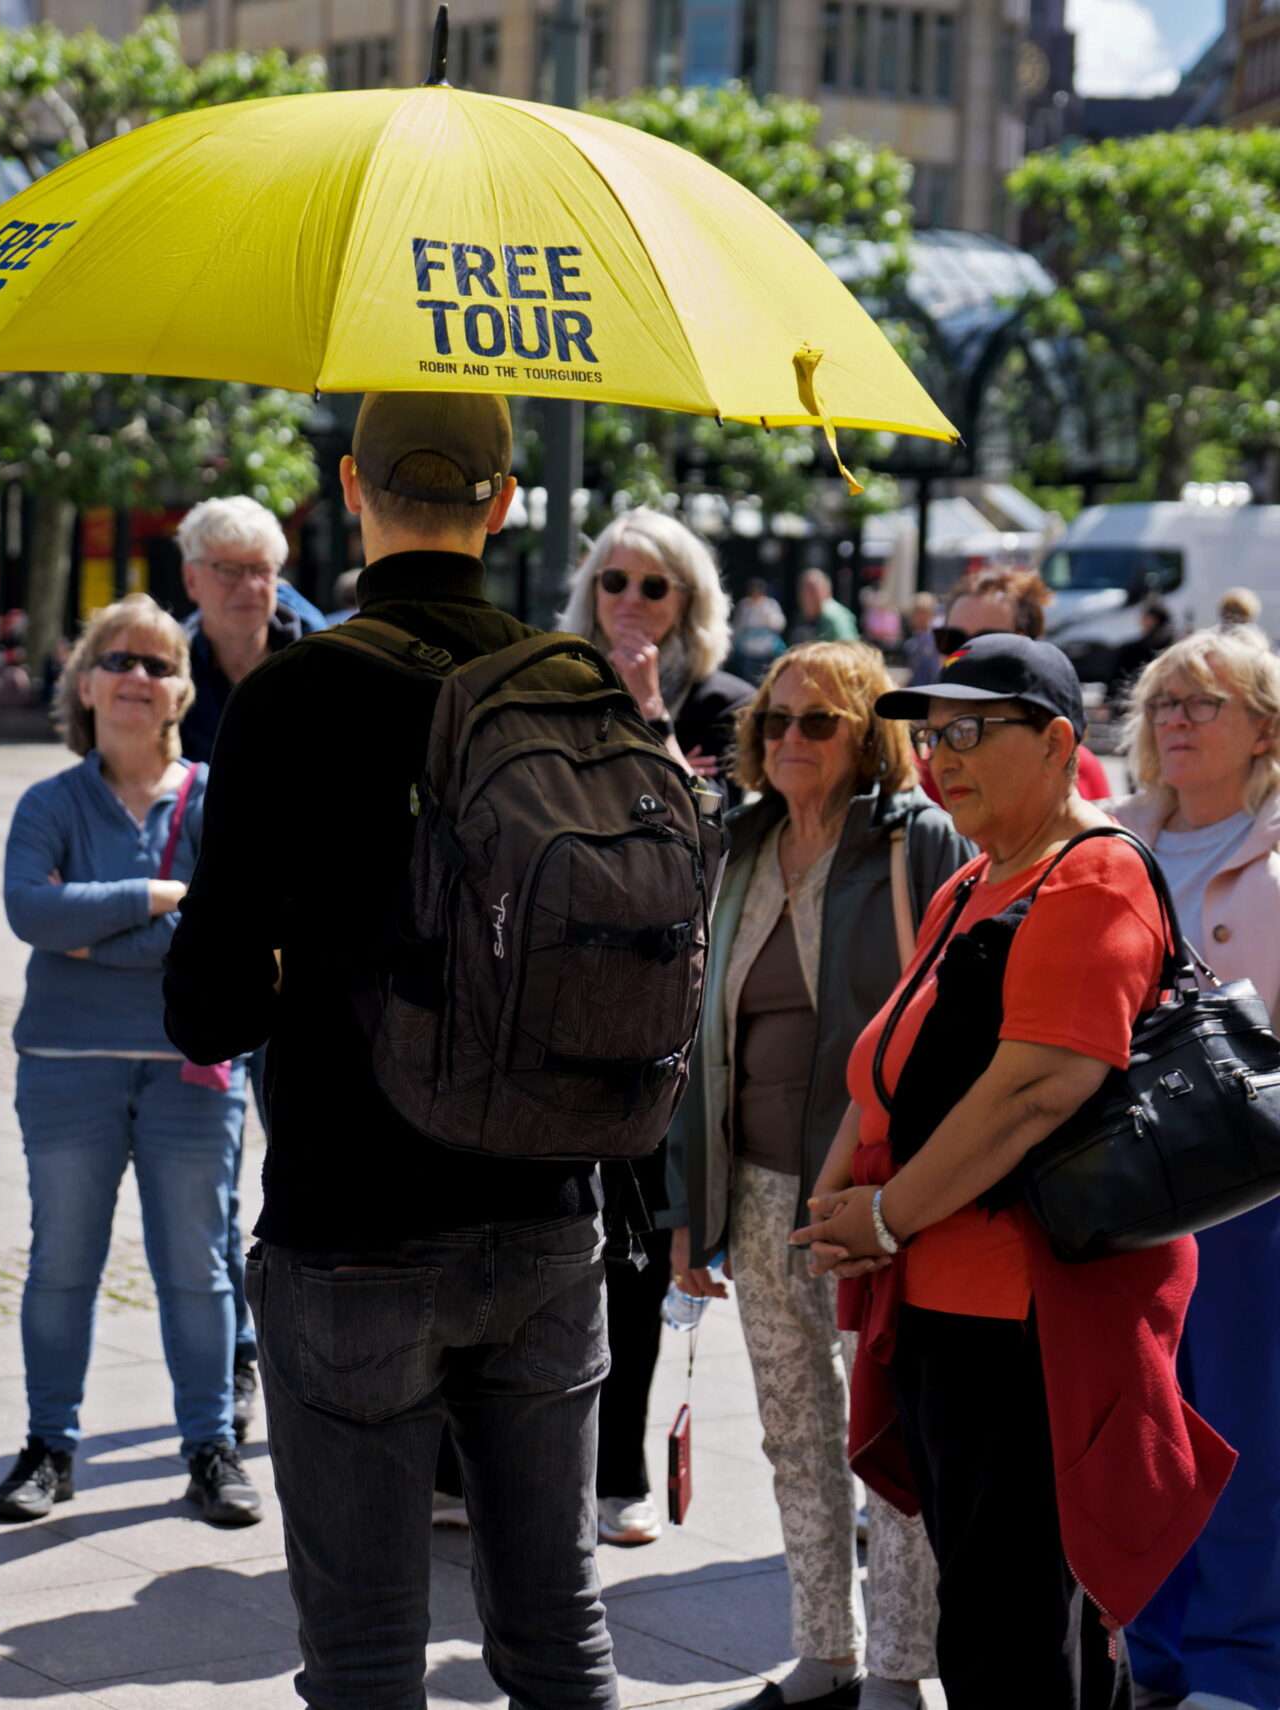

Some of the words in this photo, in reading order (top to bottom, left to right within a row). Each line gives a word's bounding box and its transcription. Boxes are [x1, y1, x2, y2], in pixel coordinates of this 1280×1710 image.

[411, 237, 592, 301] FREE
[416, 299, 599, 363] TOUR
[419, 360, 457, 374] ROBIN
[463, 363, 489, 376] AND
[495, 366, 518, 378] THE
[523, 367, 603, 383] TOURGUIDES
